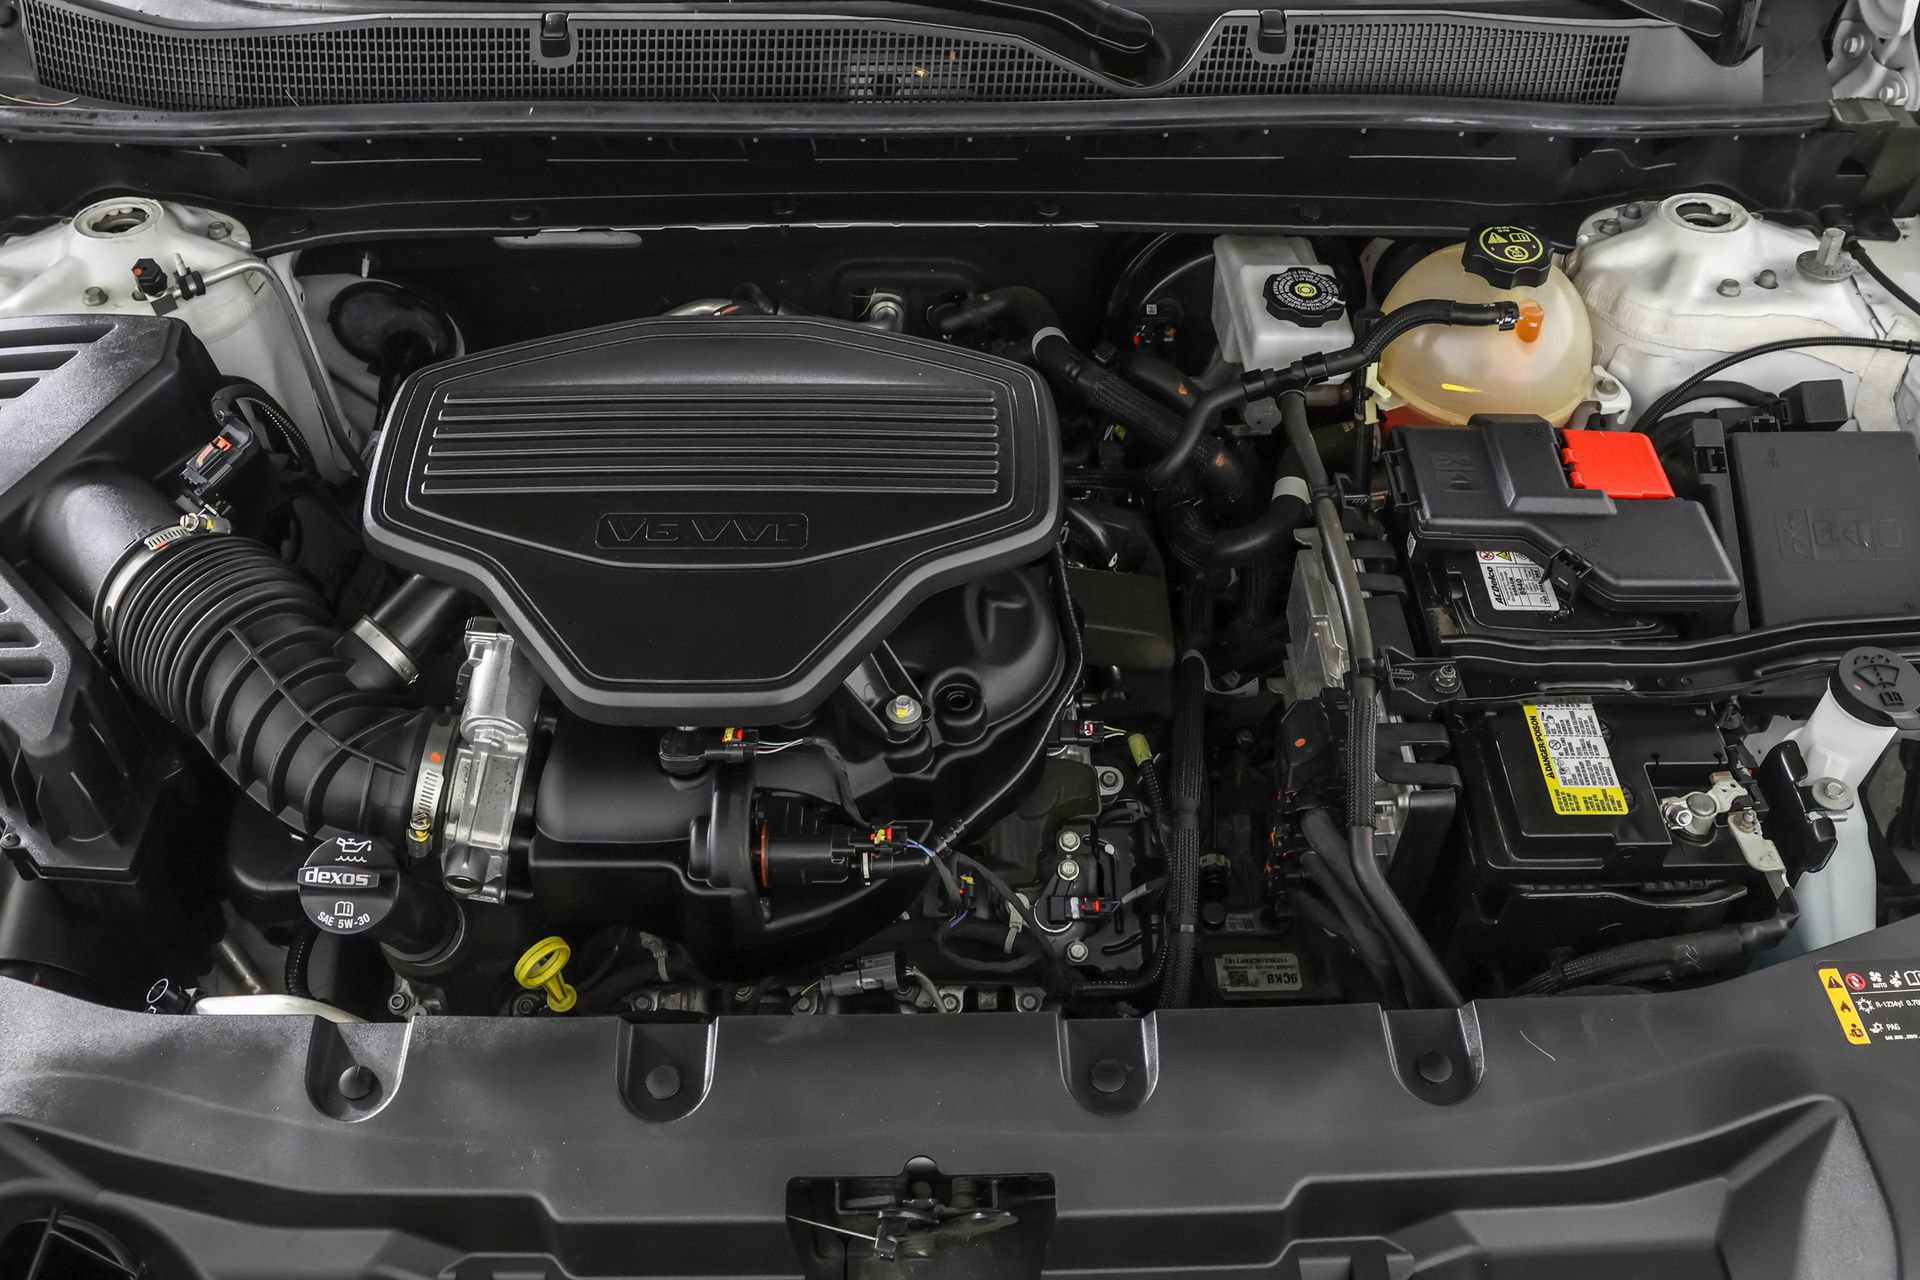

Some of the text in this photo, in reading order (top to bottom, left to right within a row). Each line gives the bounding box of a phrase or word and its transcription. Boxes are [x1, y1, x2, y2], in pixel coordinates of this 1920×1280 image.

[1487, 566, 1504, 605] ACDelco
[304, 867, 369, 886] dexos
[317, 911, 371, 929] SAE 5W-30
[1886, 1023, 1901, 1031] PAG
